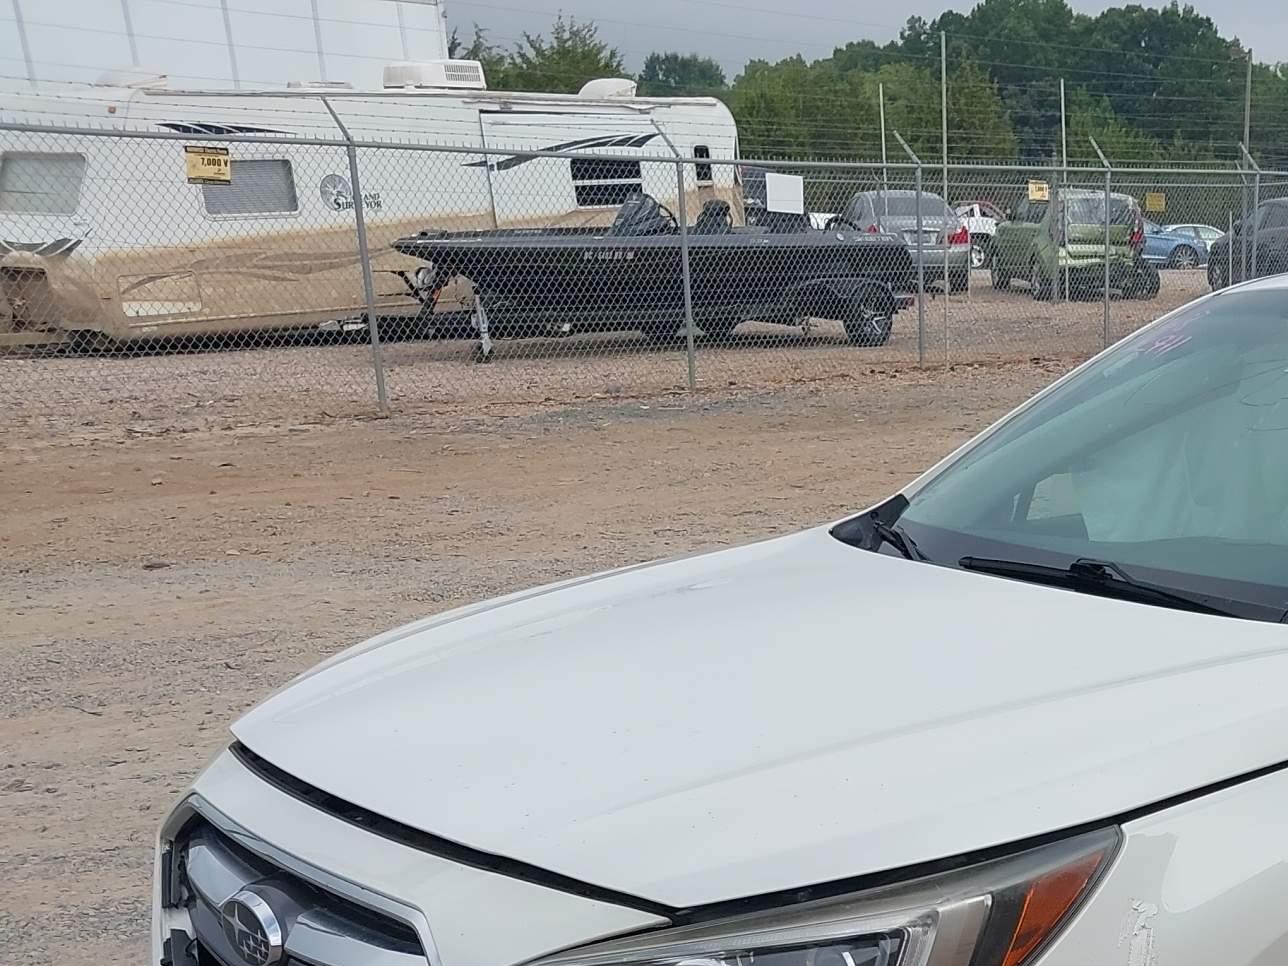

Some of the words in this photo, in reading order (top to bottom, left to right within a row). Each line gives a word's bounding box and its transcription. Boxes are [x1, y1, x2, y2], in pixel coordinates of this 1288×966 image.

[200, 157, 222, 167] 7,000
[223, 158, 229, 167] V
[333, 198, 383, 210] SURYOR
